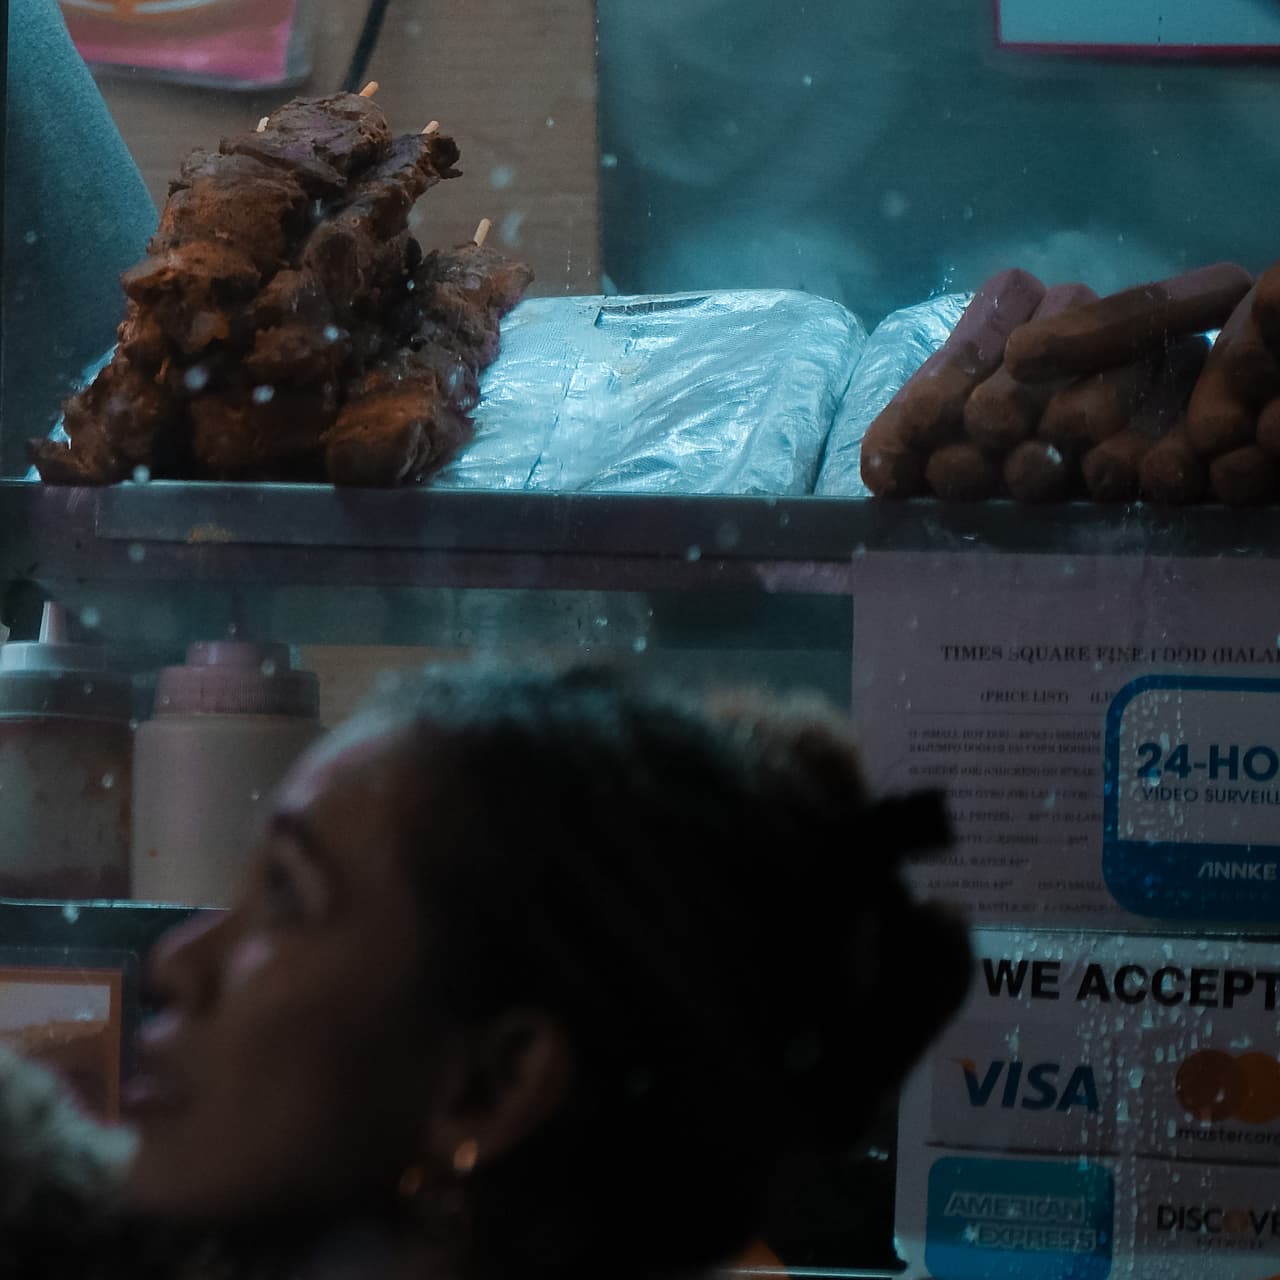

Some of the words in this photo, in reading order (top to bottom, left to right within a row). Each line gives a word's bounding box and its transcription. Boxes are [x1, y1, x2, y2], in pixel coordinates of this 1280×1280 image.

[941, 645, 1003, 662] TIMES
[1137, 742, 1280, 783] 24-HO
[1142, 787, 1198, 803] VIDEO
[983, 958, 1061, 1001] WE
[1076, 962, 1280, 1011] ACCEPT
[958, 1059, 1100, 1111] VISA
[944, 1192, 1086, 1221] AMERICAN
[970, 1222, 1097, 1252] EXPRESS
